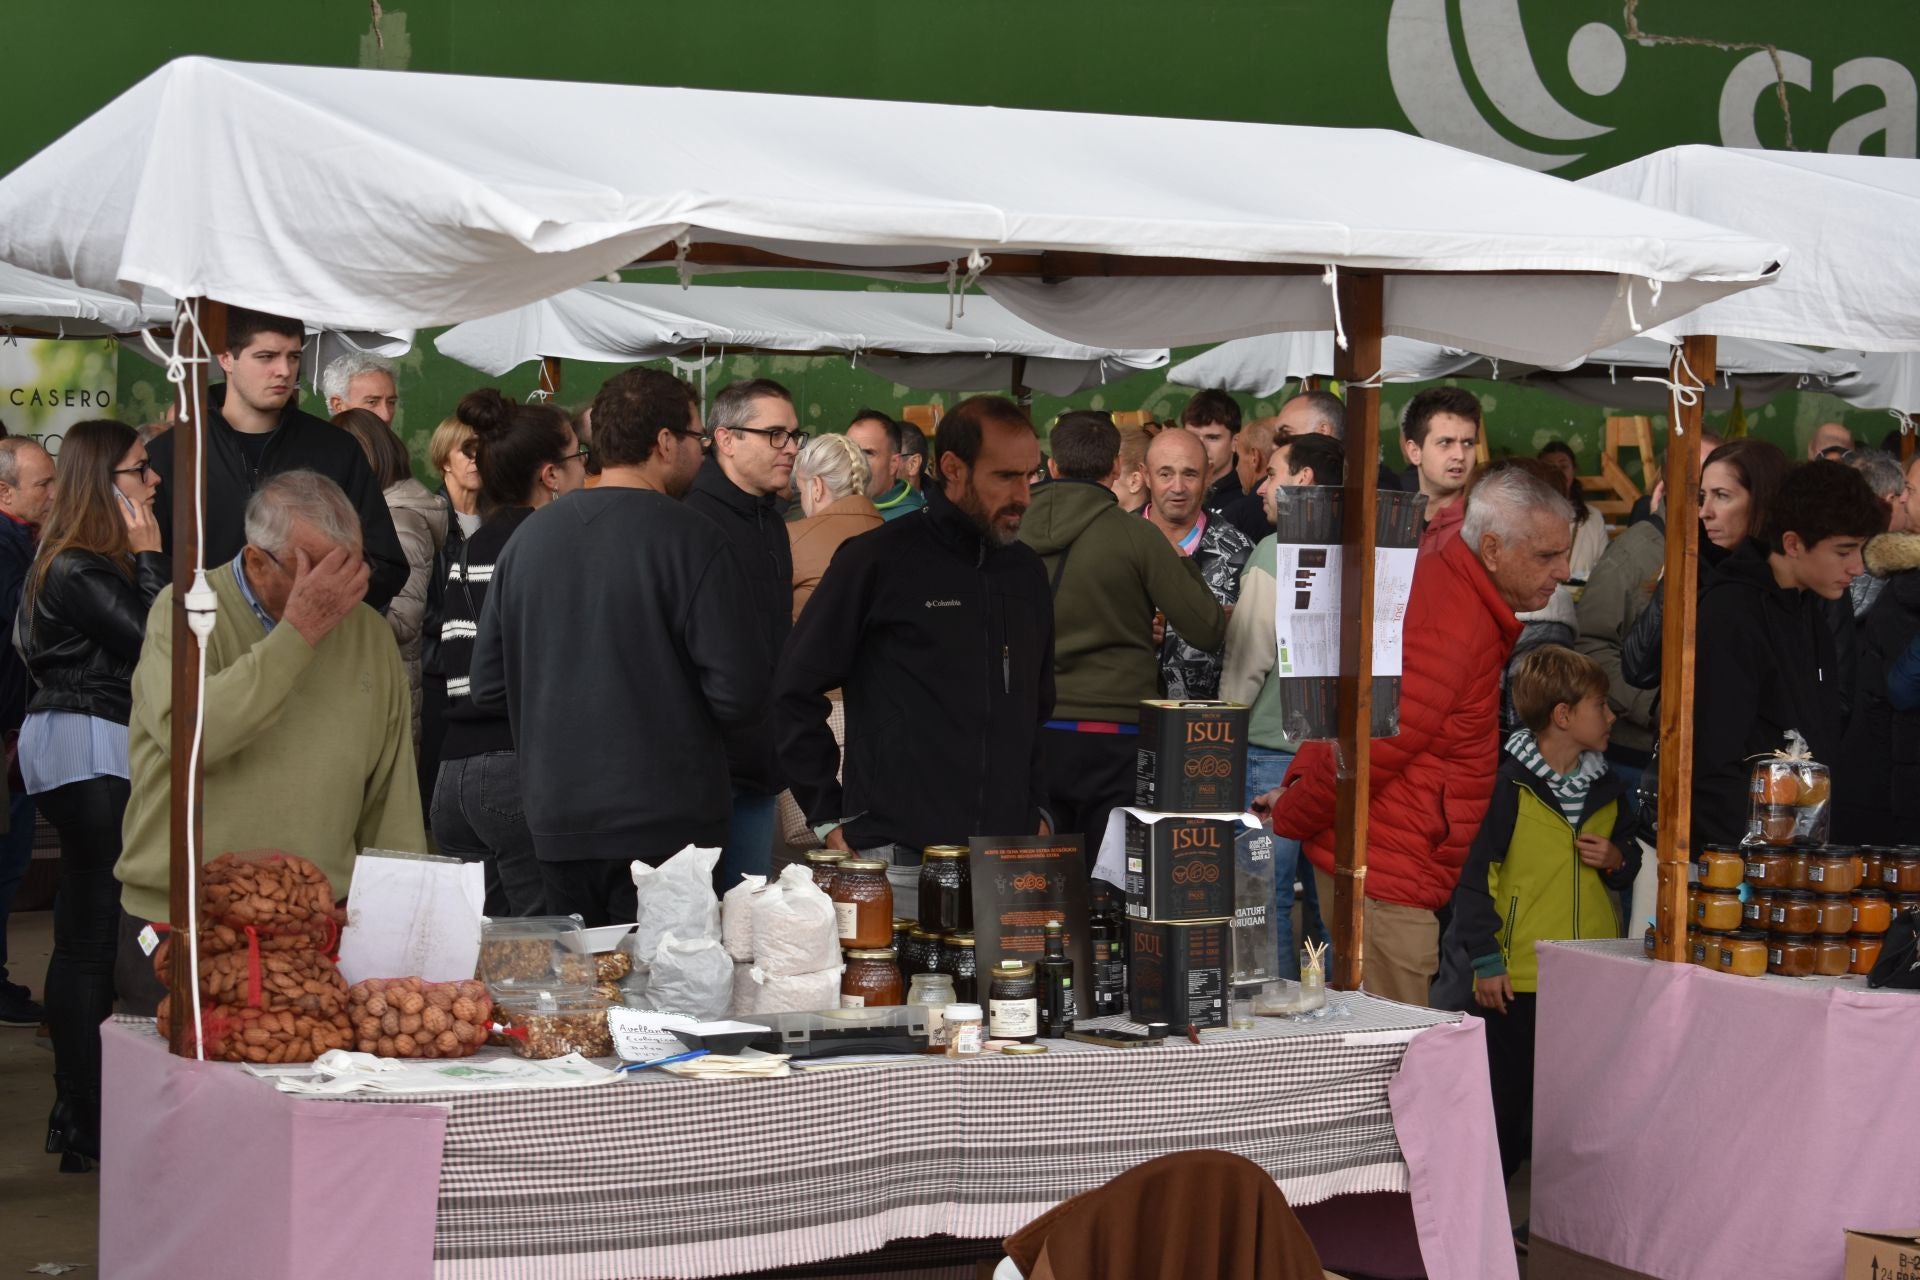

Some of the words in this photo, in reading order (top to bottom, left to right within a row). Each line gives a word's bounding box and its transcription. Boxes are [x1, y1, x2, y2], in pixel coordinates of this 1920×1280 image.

[10, 388, 111, 408] CASERO
[1184, 721, 1235, 743] ISUL
[1171, 827, 1222, 850] ISUL
[1134, 931, 1164, 958] ISUL
